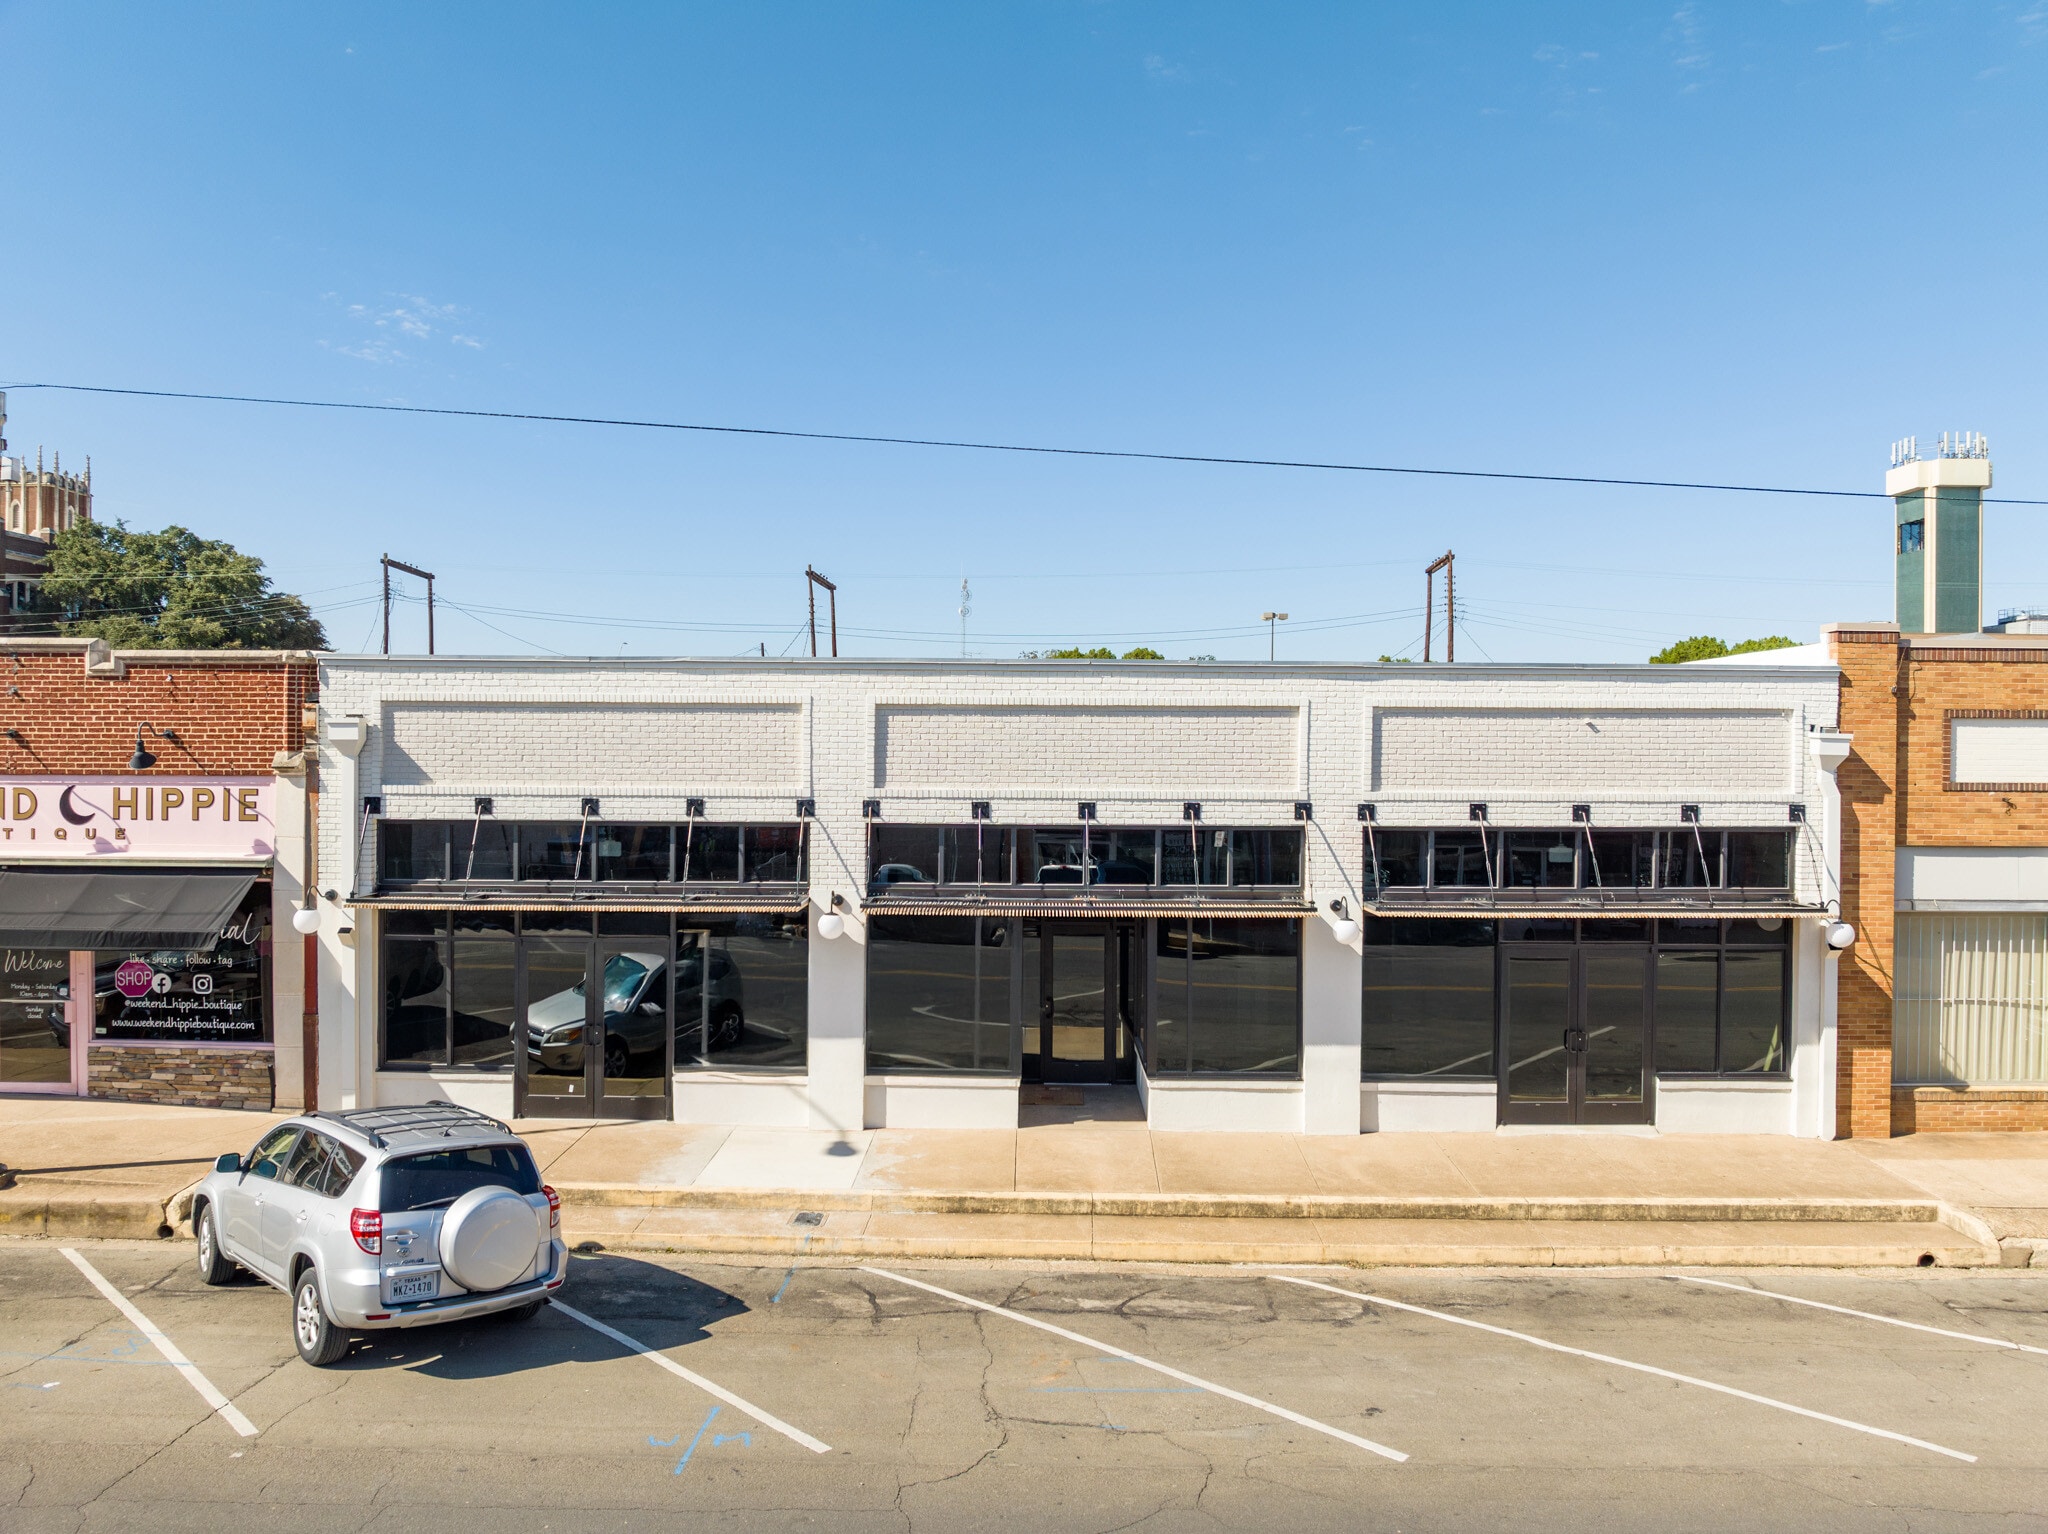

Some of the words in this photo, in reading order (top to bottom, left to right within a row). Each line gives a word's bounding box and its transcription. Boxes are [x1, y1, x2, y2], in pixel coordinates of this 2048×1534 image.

[0, 787, 38, 820] D
[112, 787, 259, 821] HIPPIE
[2, 828, 126, 840] TIQUE
[4, 949, 65, 973] Welcome
[130, 952, 145, 964] like
[152, 954, 178, 964] share
[186, 954, 211, 967] follow
[218, 954, 233, 968] tag
[117, 971, 152, 986] SHOP
[10, 983, 31, 991] Monday
[35, 983, 58, 991] Saturday
[25, 1006, 45, 1014] Sunday
[124, 997, 242, 1015] @weekend_hippie_boutique
[112, 1015, 255, 1034] www.weekendhippieboutique.com
